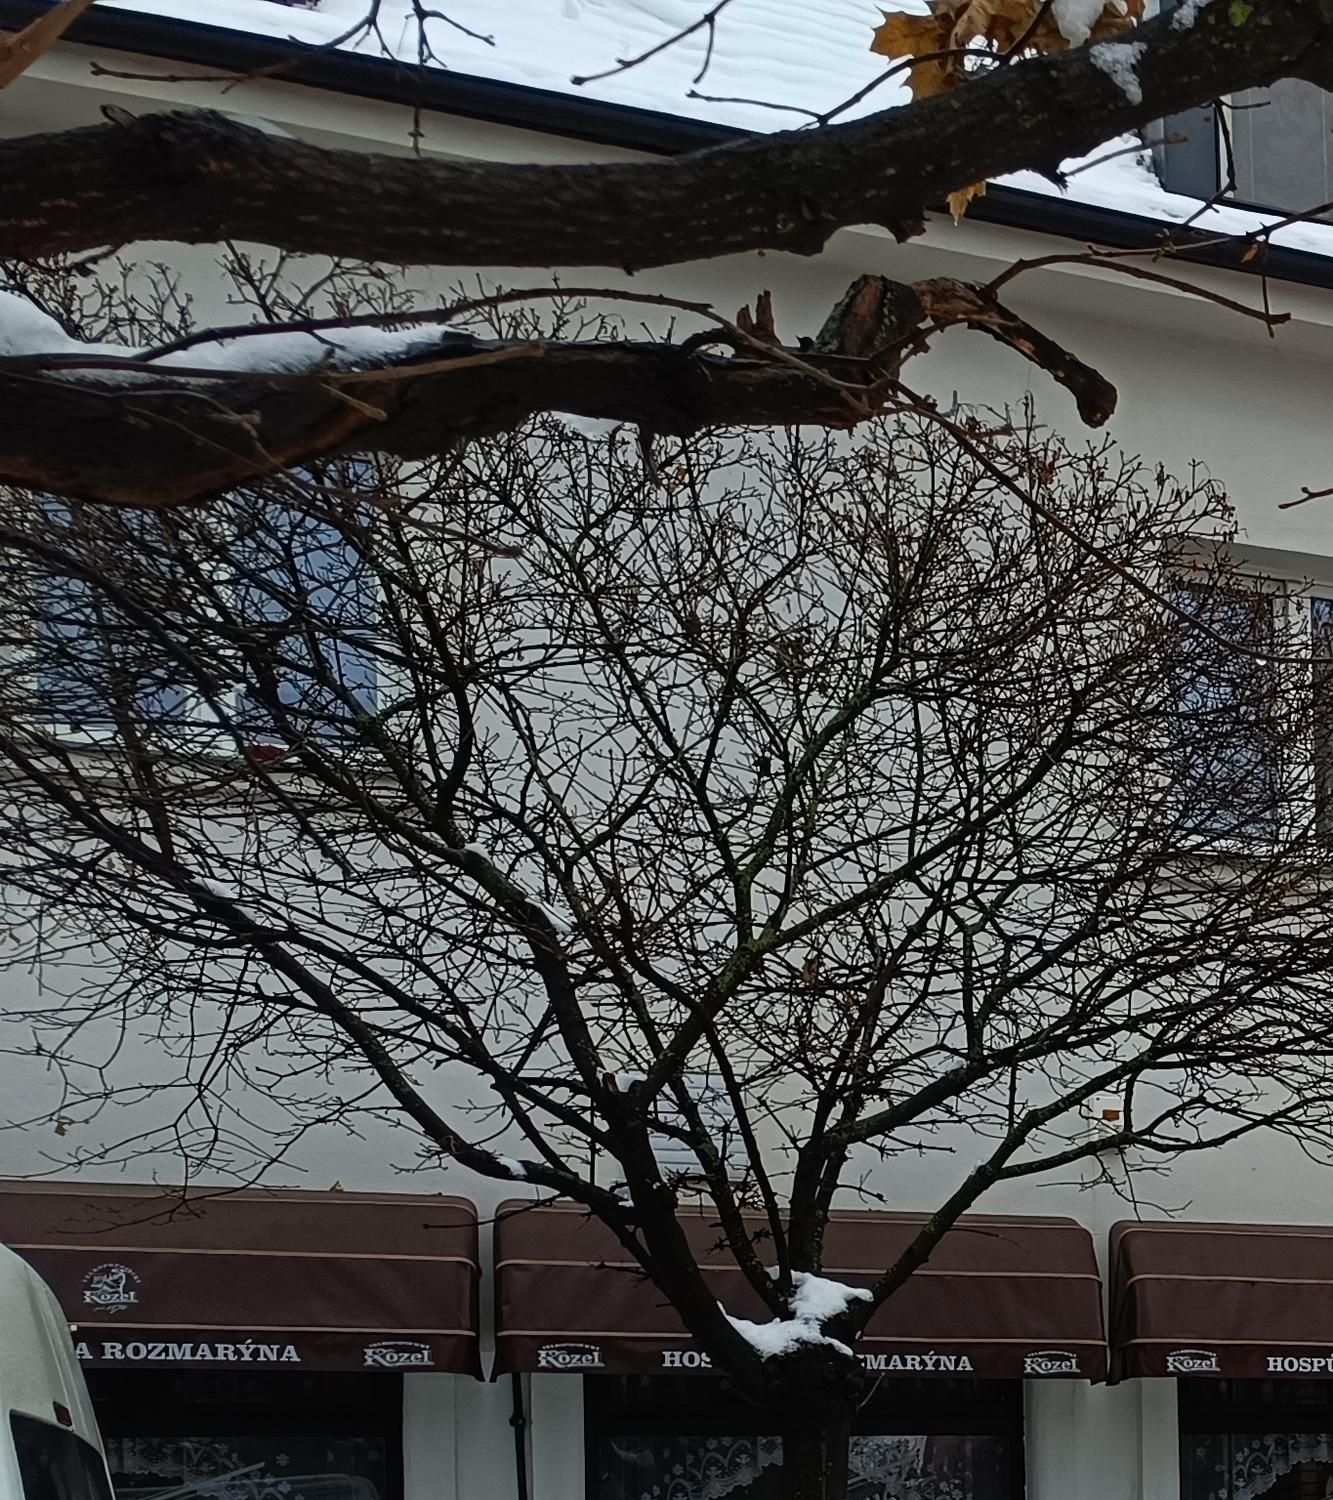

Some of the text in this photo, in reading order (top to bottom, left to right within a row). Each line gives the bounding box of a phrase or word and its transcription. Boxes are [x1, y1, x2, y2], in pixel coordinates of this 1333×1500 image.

[101, 1339, 302, 1362] ROZMARÝNA
[363, 1348, 435, 1367] Kozel
[537, 1350, 606, 1368] Kozel
[856, 1350, 974, 1371] MARÝNA
[1024, 1357, 1081, 1374] Kozel
[1166, 1356, 1221, 1372] Kozel
